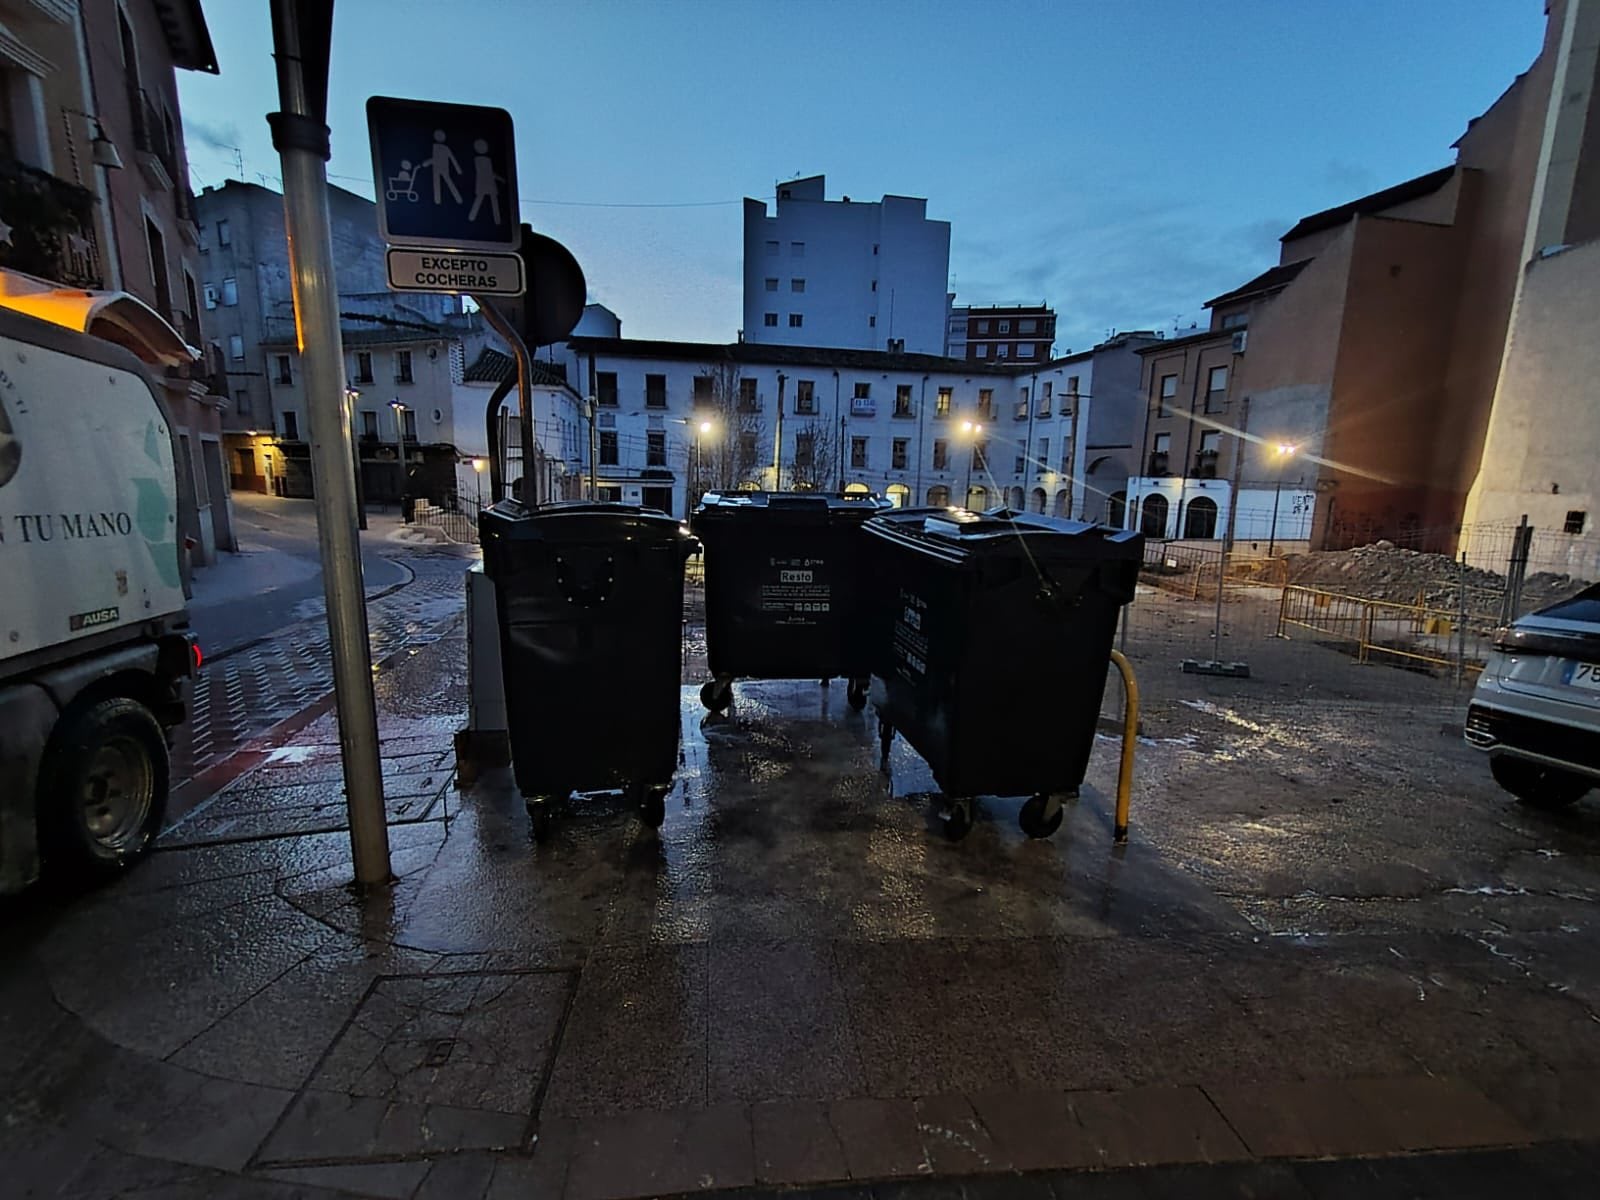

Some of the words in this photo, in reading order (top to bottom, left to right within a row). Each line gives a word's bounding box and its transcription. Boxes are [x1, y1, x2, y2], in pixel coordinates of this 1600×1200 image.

[421, 257, 488, 272] EXCEPTO
[415, 272, 497, 287] COCHERAS
[14, 513, 53, 543] TU
[60, 511, 132, 540] MANO
[782, 571, 811, 581] Resto
[83, 609, 118, 626] AUSA
